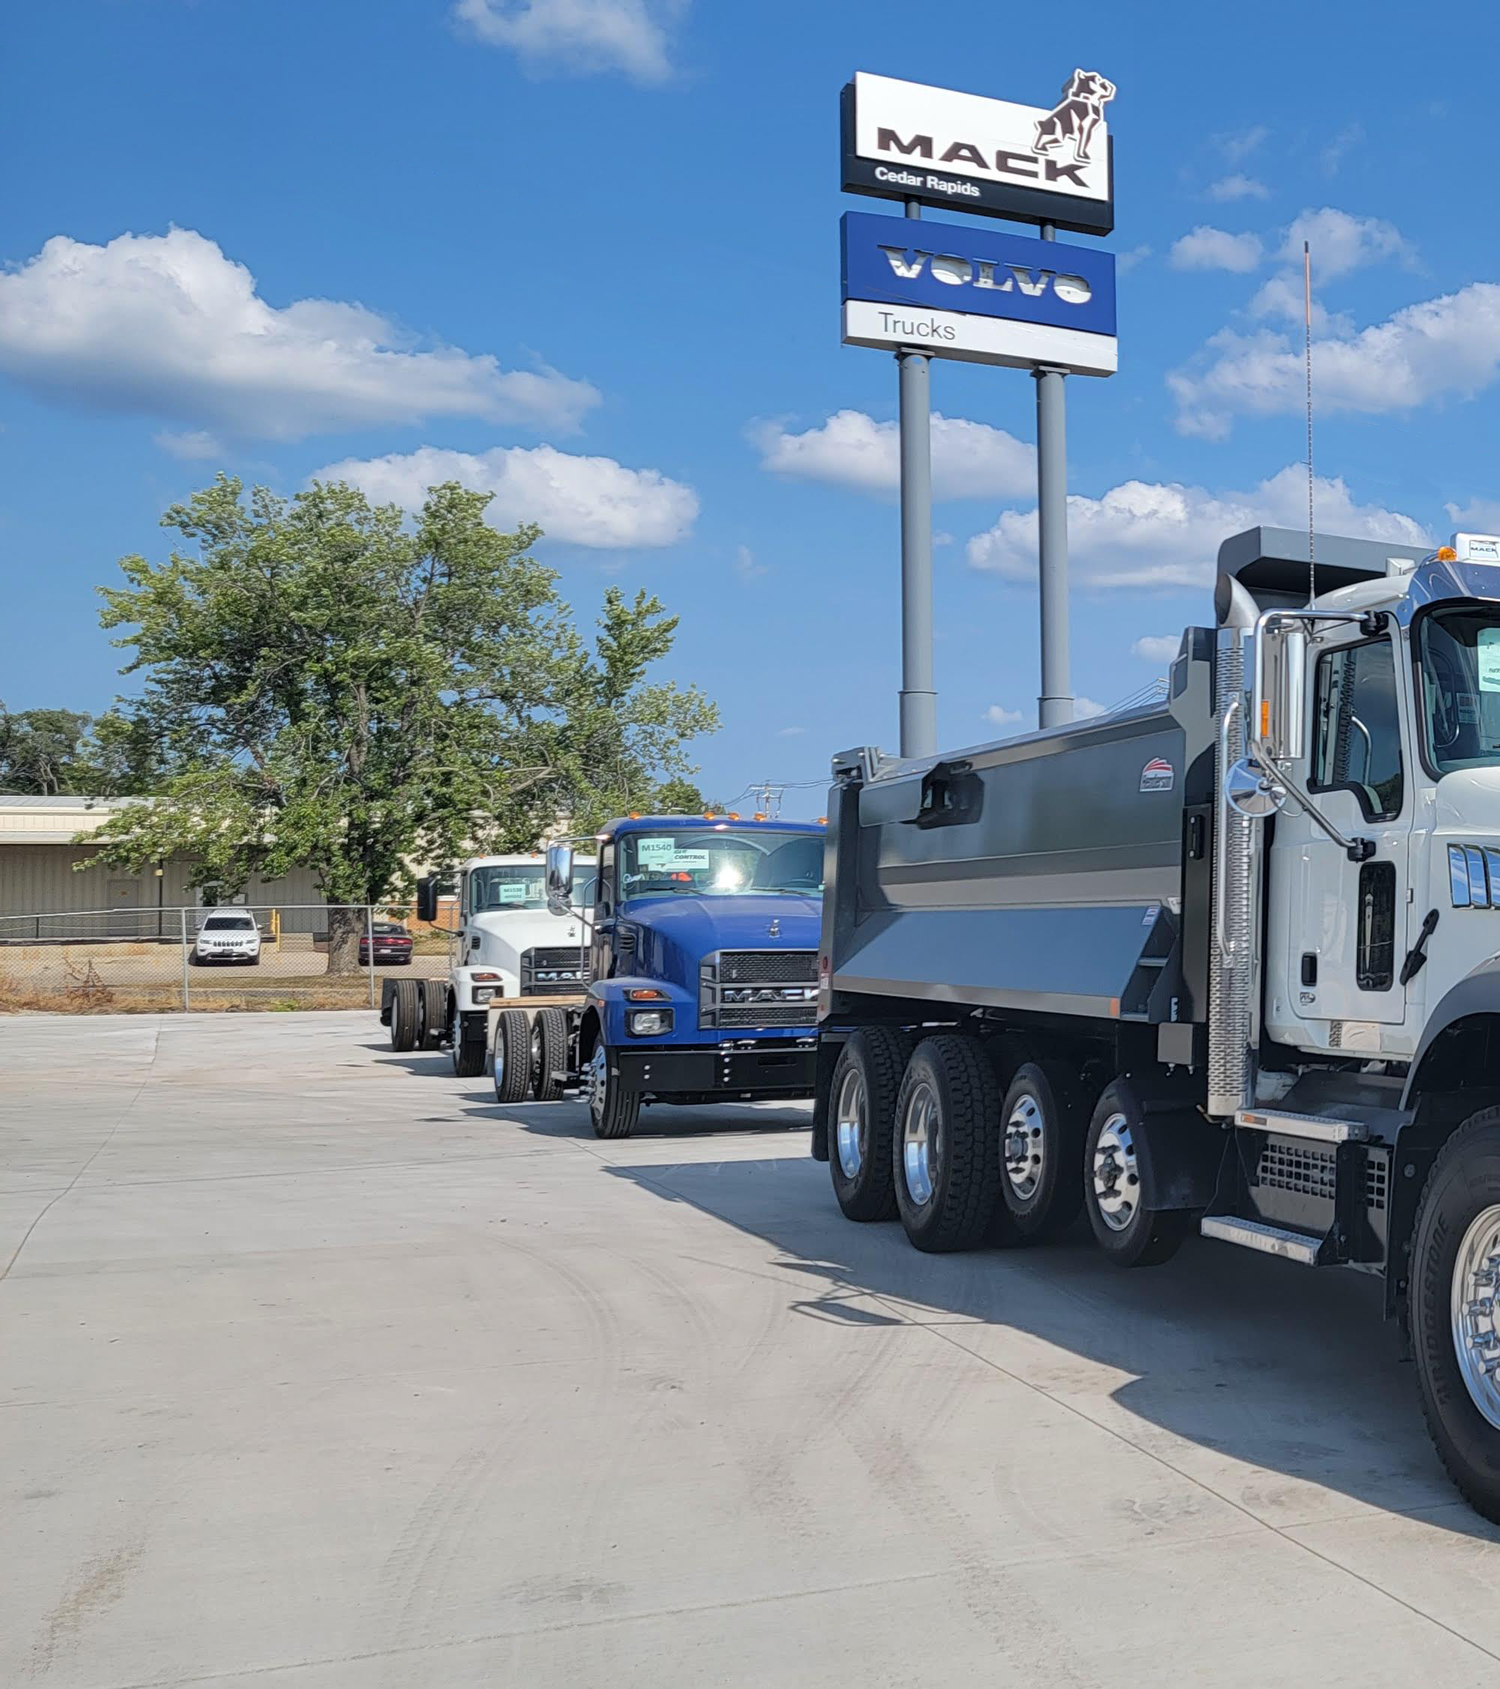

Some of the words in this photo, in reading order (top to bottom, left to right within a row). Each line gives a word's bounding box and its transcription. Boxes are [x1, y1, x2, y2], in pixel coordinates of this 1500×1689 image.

[877, 127, 1091, 189] MACK
[874, 167, 924, 188] Cedar
[926, 175, 981, 197] Rapids
[877, 244, 1092, 304] VOLVO
[878, 311, 956, 340] Trucks
[641, 844, 672, 852] M1540
[537, 971, 591, 981] MAC
